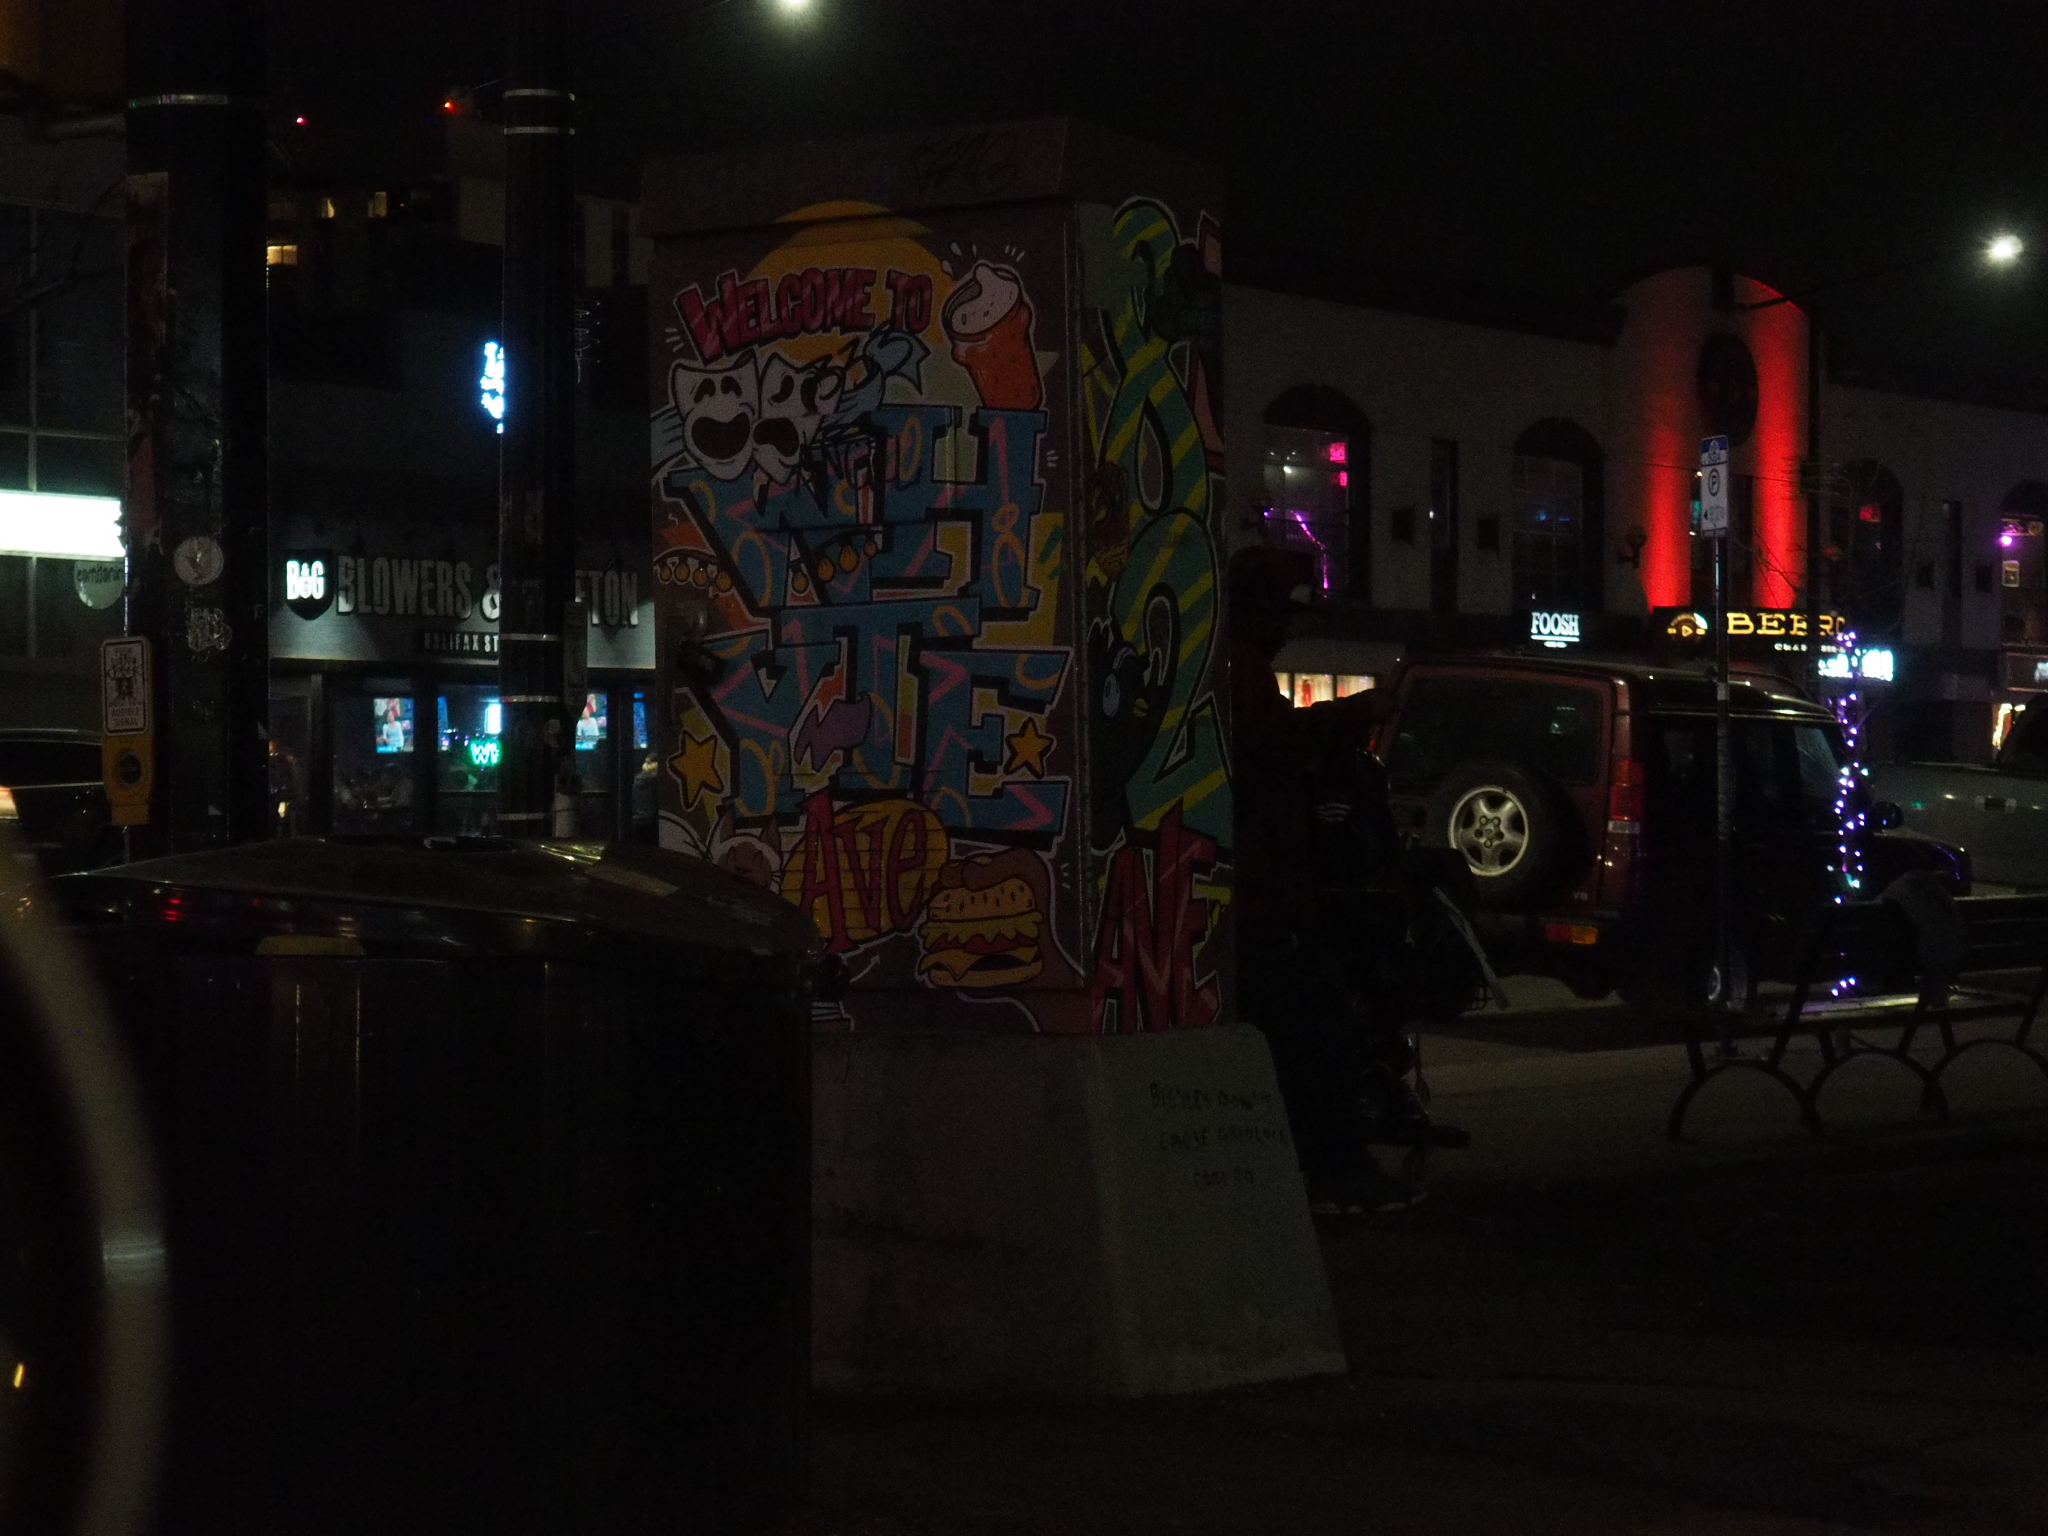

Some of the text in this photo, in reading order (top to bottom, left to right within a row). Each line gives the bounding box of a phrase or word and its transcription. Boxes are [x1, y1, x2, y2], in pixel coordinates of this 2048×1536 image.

[676, 268, 876, 362] WELCOME
[886, 269, 933, 334] TO
[286, 560, 325, 600] B&G
[337, 555, 472, 620] BLOWERS
[482, 564, 501, 621] &
[424, 632, 479, 651] HALIFAX
[1530, 611, 1580, 636] FOOSH
